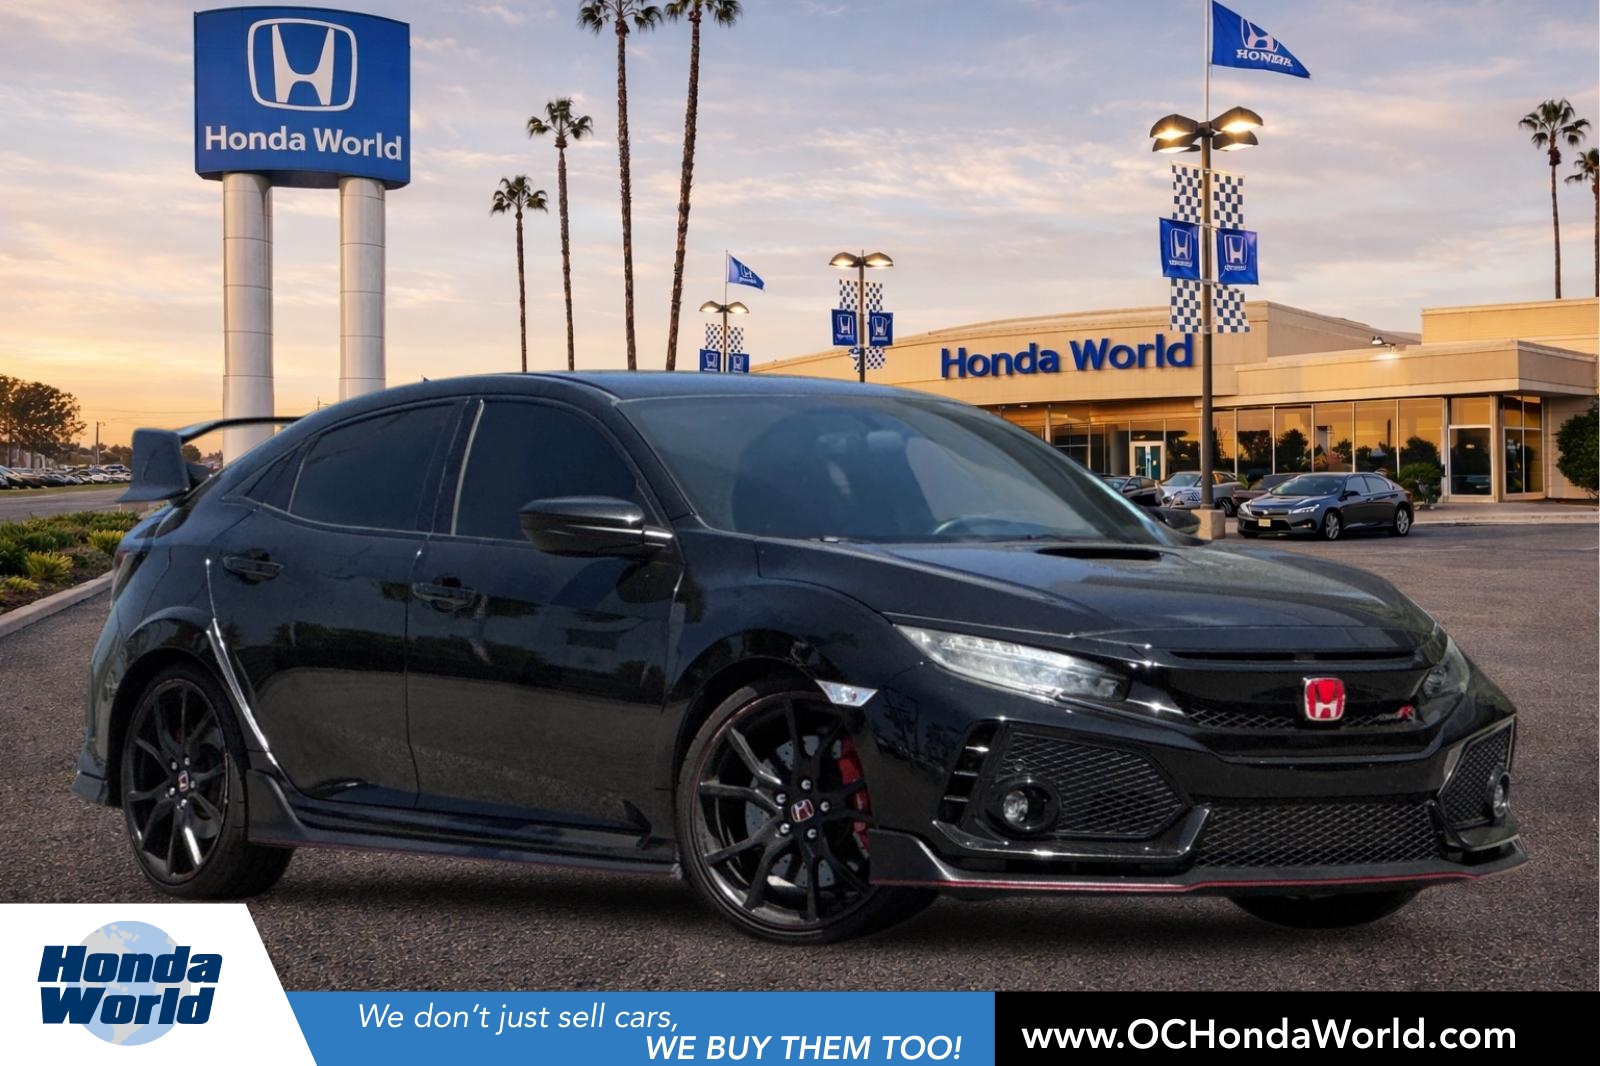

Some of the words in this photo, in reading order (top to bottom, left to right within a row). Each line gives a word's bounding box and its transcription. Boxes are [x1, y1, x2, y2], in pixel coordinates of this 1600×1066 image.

[205, 125, 306, 151] Honda
[313, 127, 402, 160] World
[941, 342, 1060, 378] Honda
[1069, 333, 1193, 370] World
